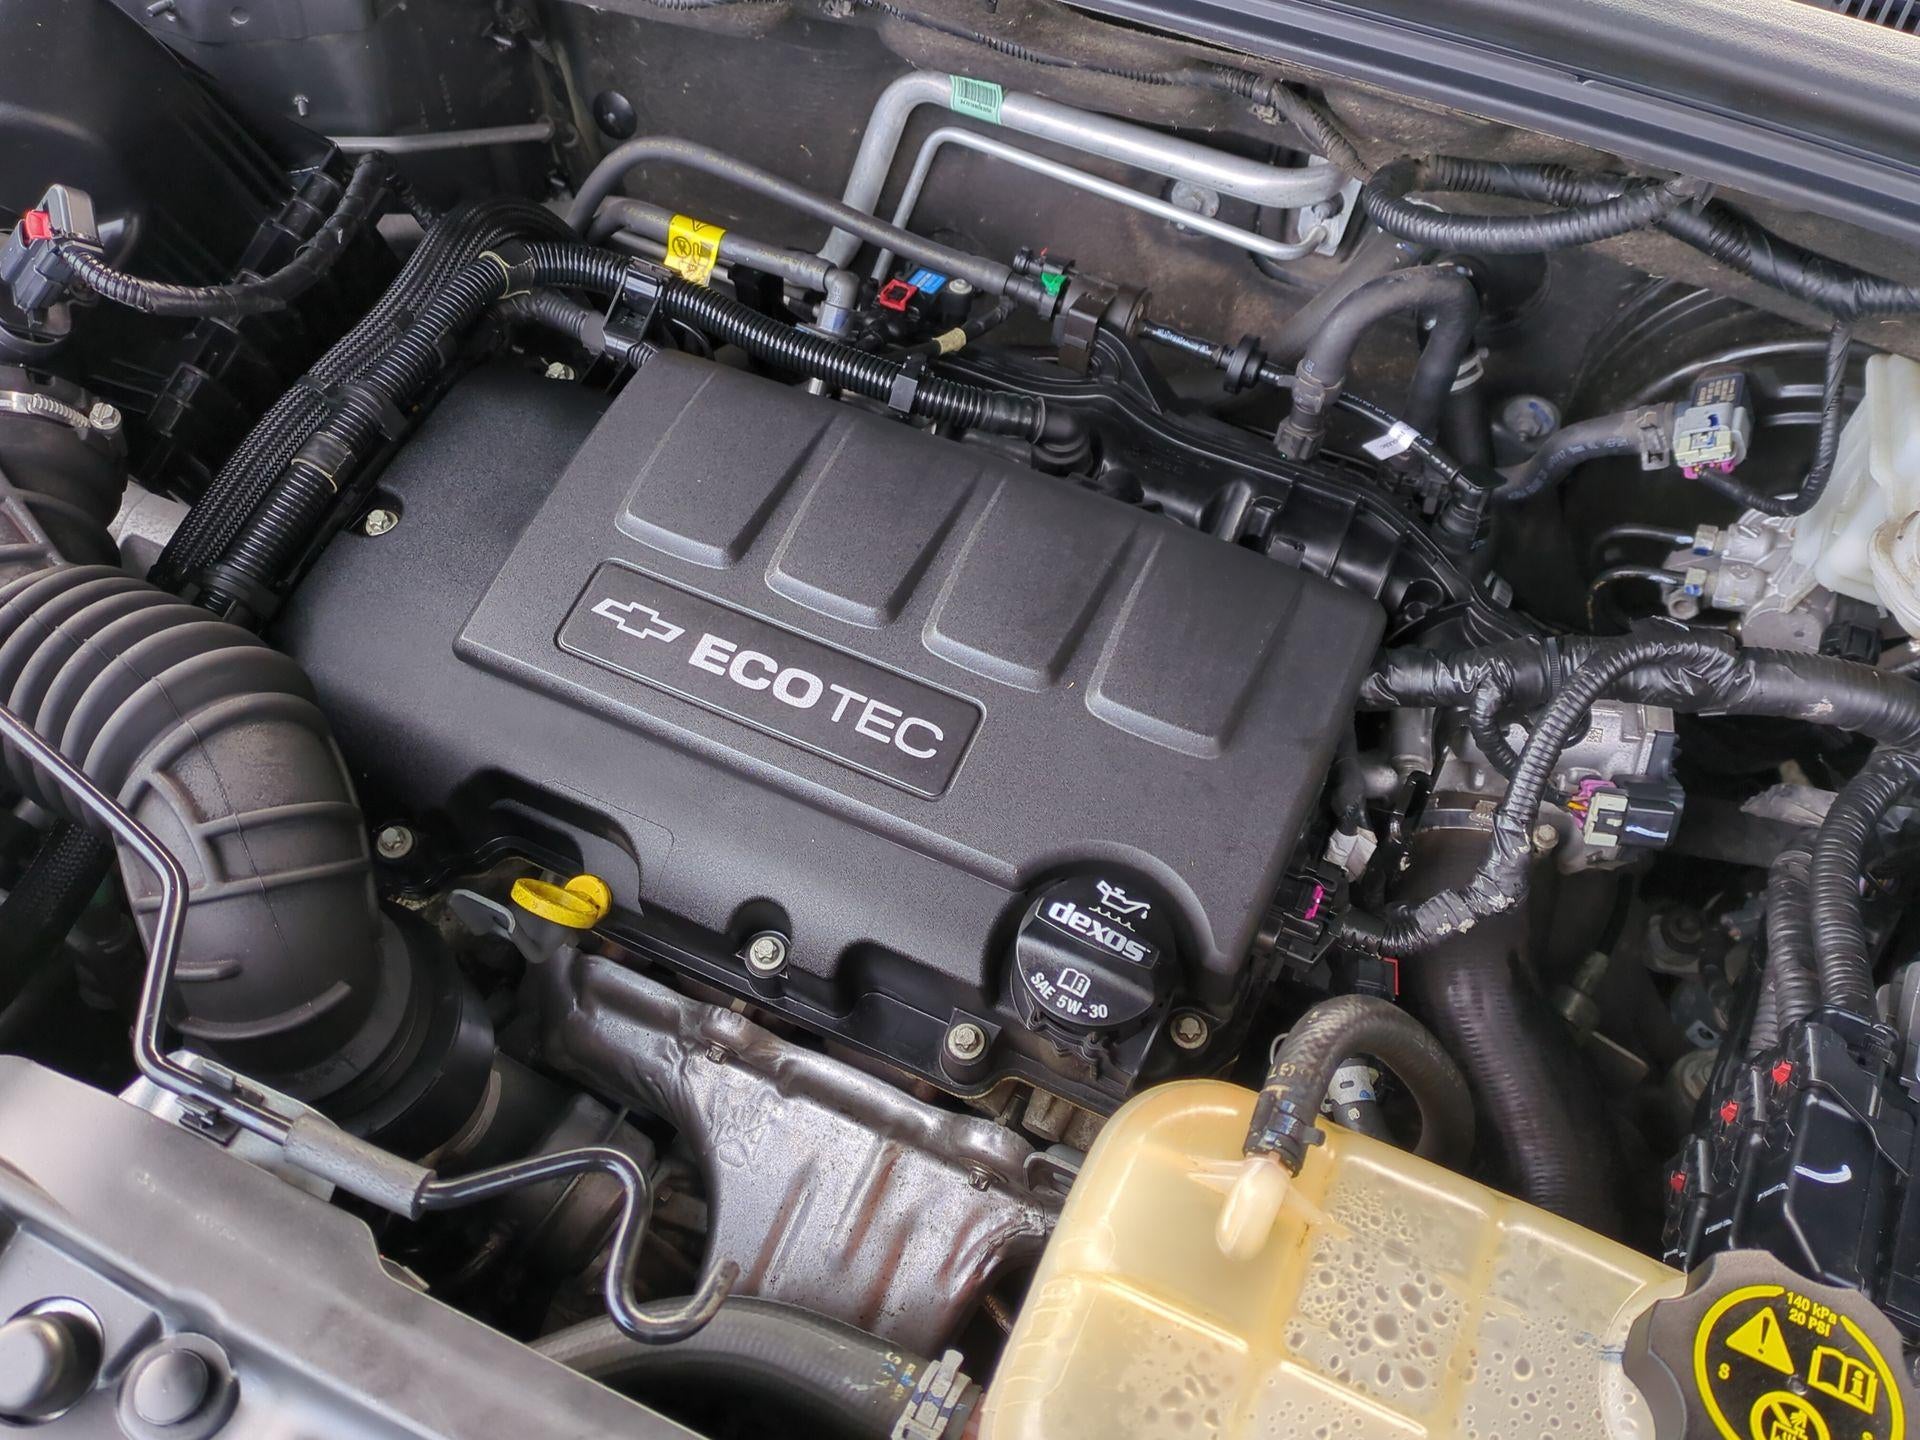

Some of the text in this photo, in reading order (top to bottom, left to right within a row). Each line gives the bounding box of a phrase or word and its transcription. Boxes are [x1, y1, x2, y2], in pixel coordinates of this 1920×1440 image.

[688, 632, 945, 760] ECOTEC
[1048, 901, 1147, 962] dexos
[1030, 971, 1109, 1019] SAE 5W-30
[1786, 1291, 1838, 1326] 140 kPa
[1788, 1307, 1831, 1338] 20 PSI
